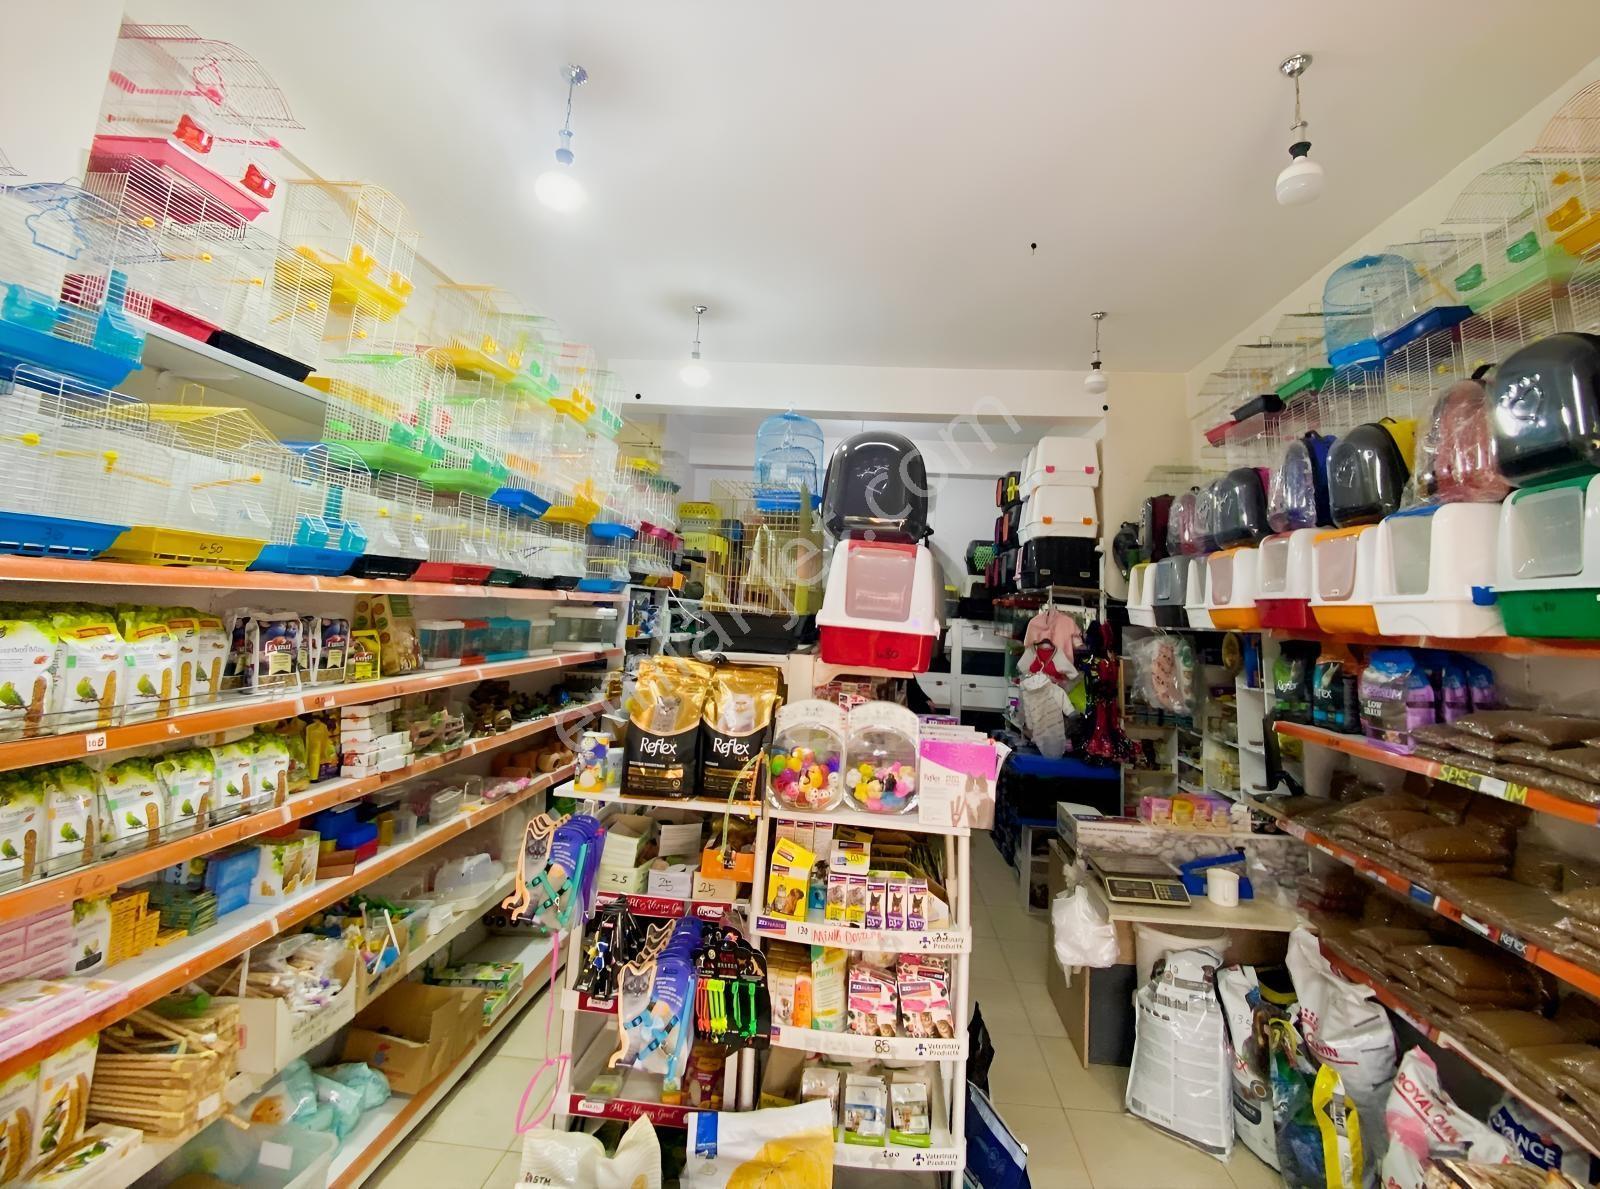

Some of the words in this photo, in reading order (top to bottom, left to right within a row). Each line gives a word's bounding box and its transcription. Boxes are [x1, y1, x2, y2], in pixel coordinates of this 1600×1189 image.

[640, 737, 678, 758] Reflex
[713, 737, 750, 758] Reflex
[611, 873, 628, 884] 25
[698, 881, 716, 897] 25
[874, 1039, 891, 1054] 85
[1399, 1071, 1432, 1117] ROYAL
